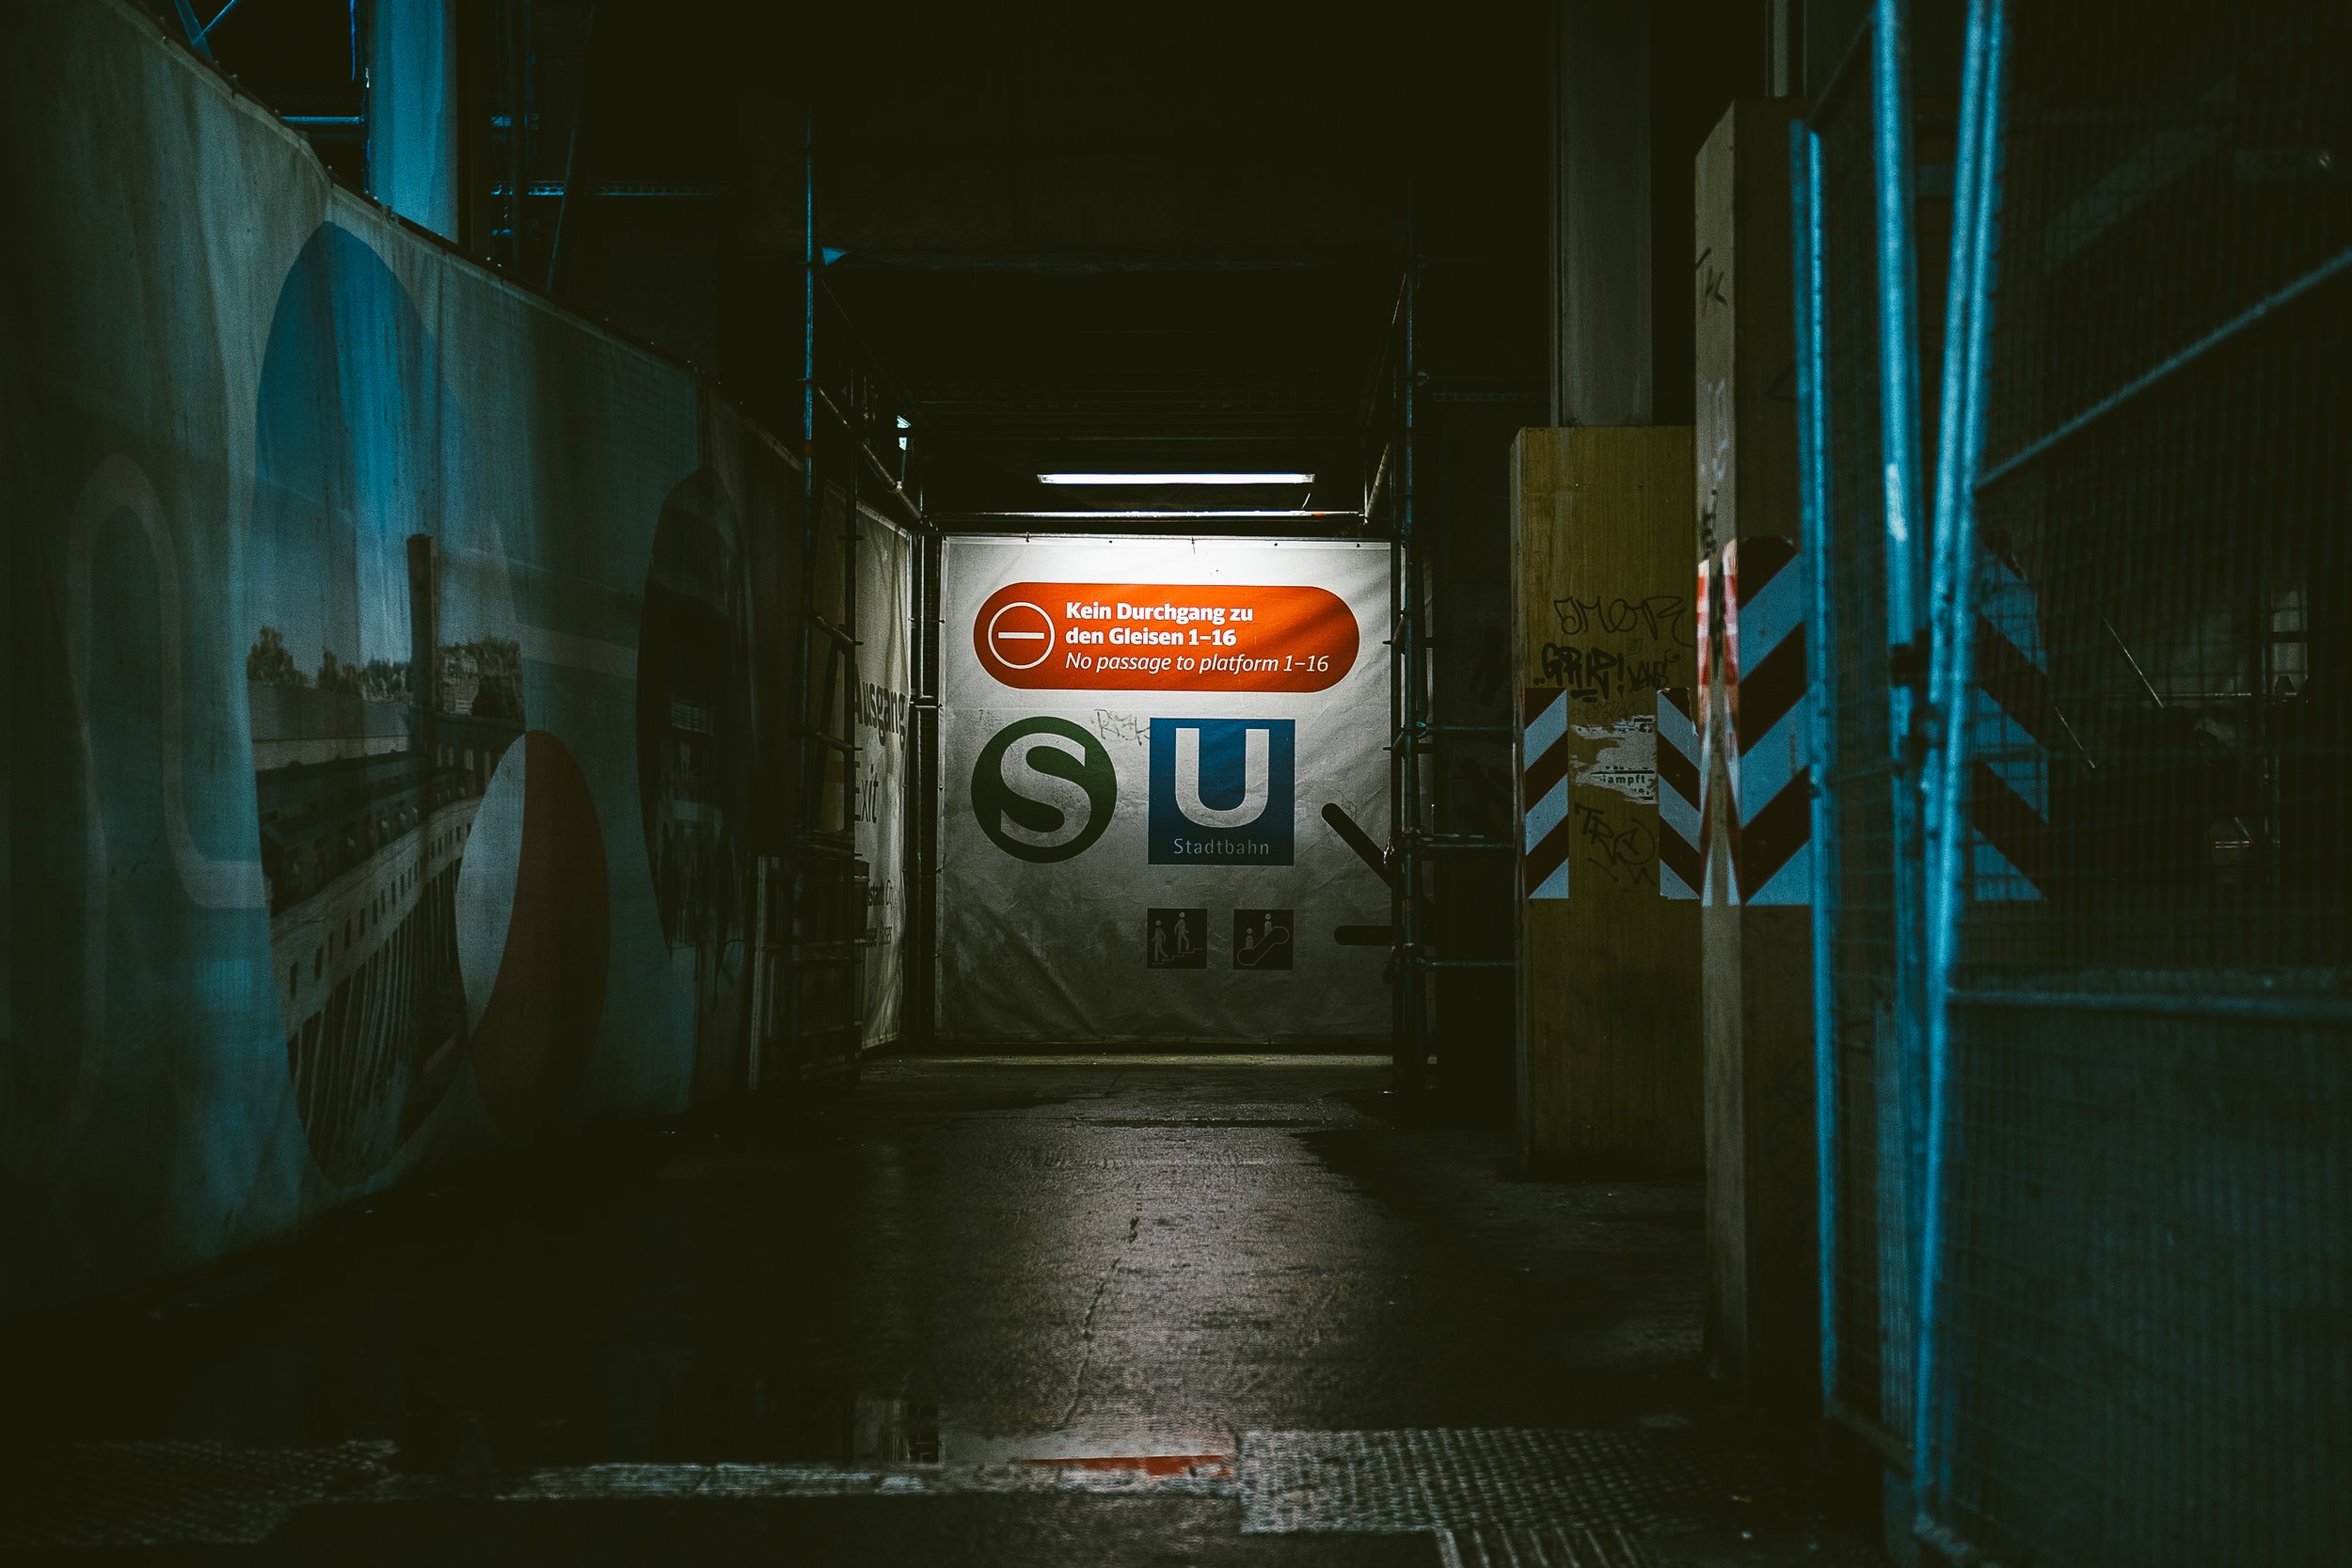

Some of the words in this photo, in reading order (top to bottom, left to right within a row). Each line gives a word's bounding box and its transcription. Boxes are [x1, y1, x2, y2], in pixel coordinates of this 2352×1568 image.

[1065, 601, 1112, 620] Kein
[1116, 602, 1226, 626] Durchgang
[1229, 607, 1254, 622] zu
[1065, 626, 1104, 644] den
[1108, 627, 1184, 646] Gleisen
[1064, 652, 1091, 670] No
[1095, 656, 1172, 674] passage
[1176, 656, 1196, 671] to
[1199, 654, 1280, 674] platform
[999, 732, 1092, 847] S
[1174, 727, 1270, 829] U
[1173, 837, 1270, 855] Stadtbahn
